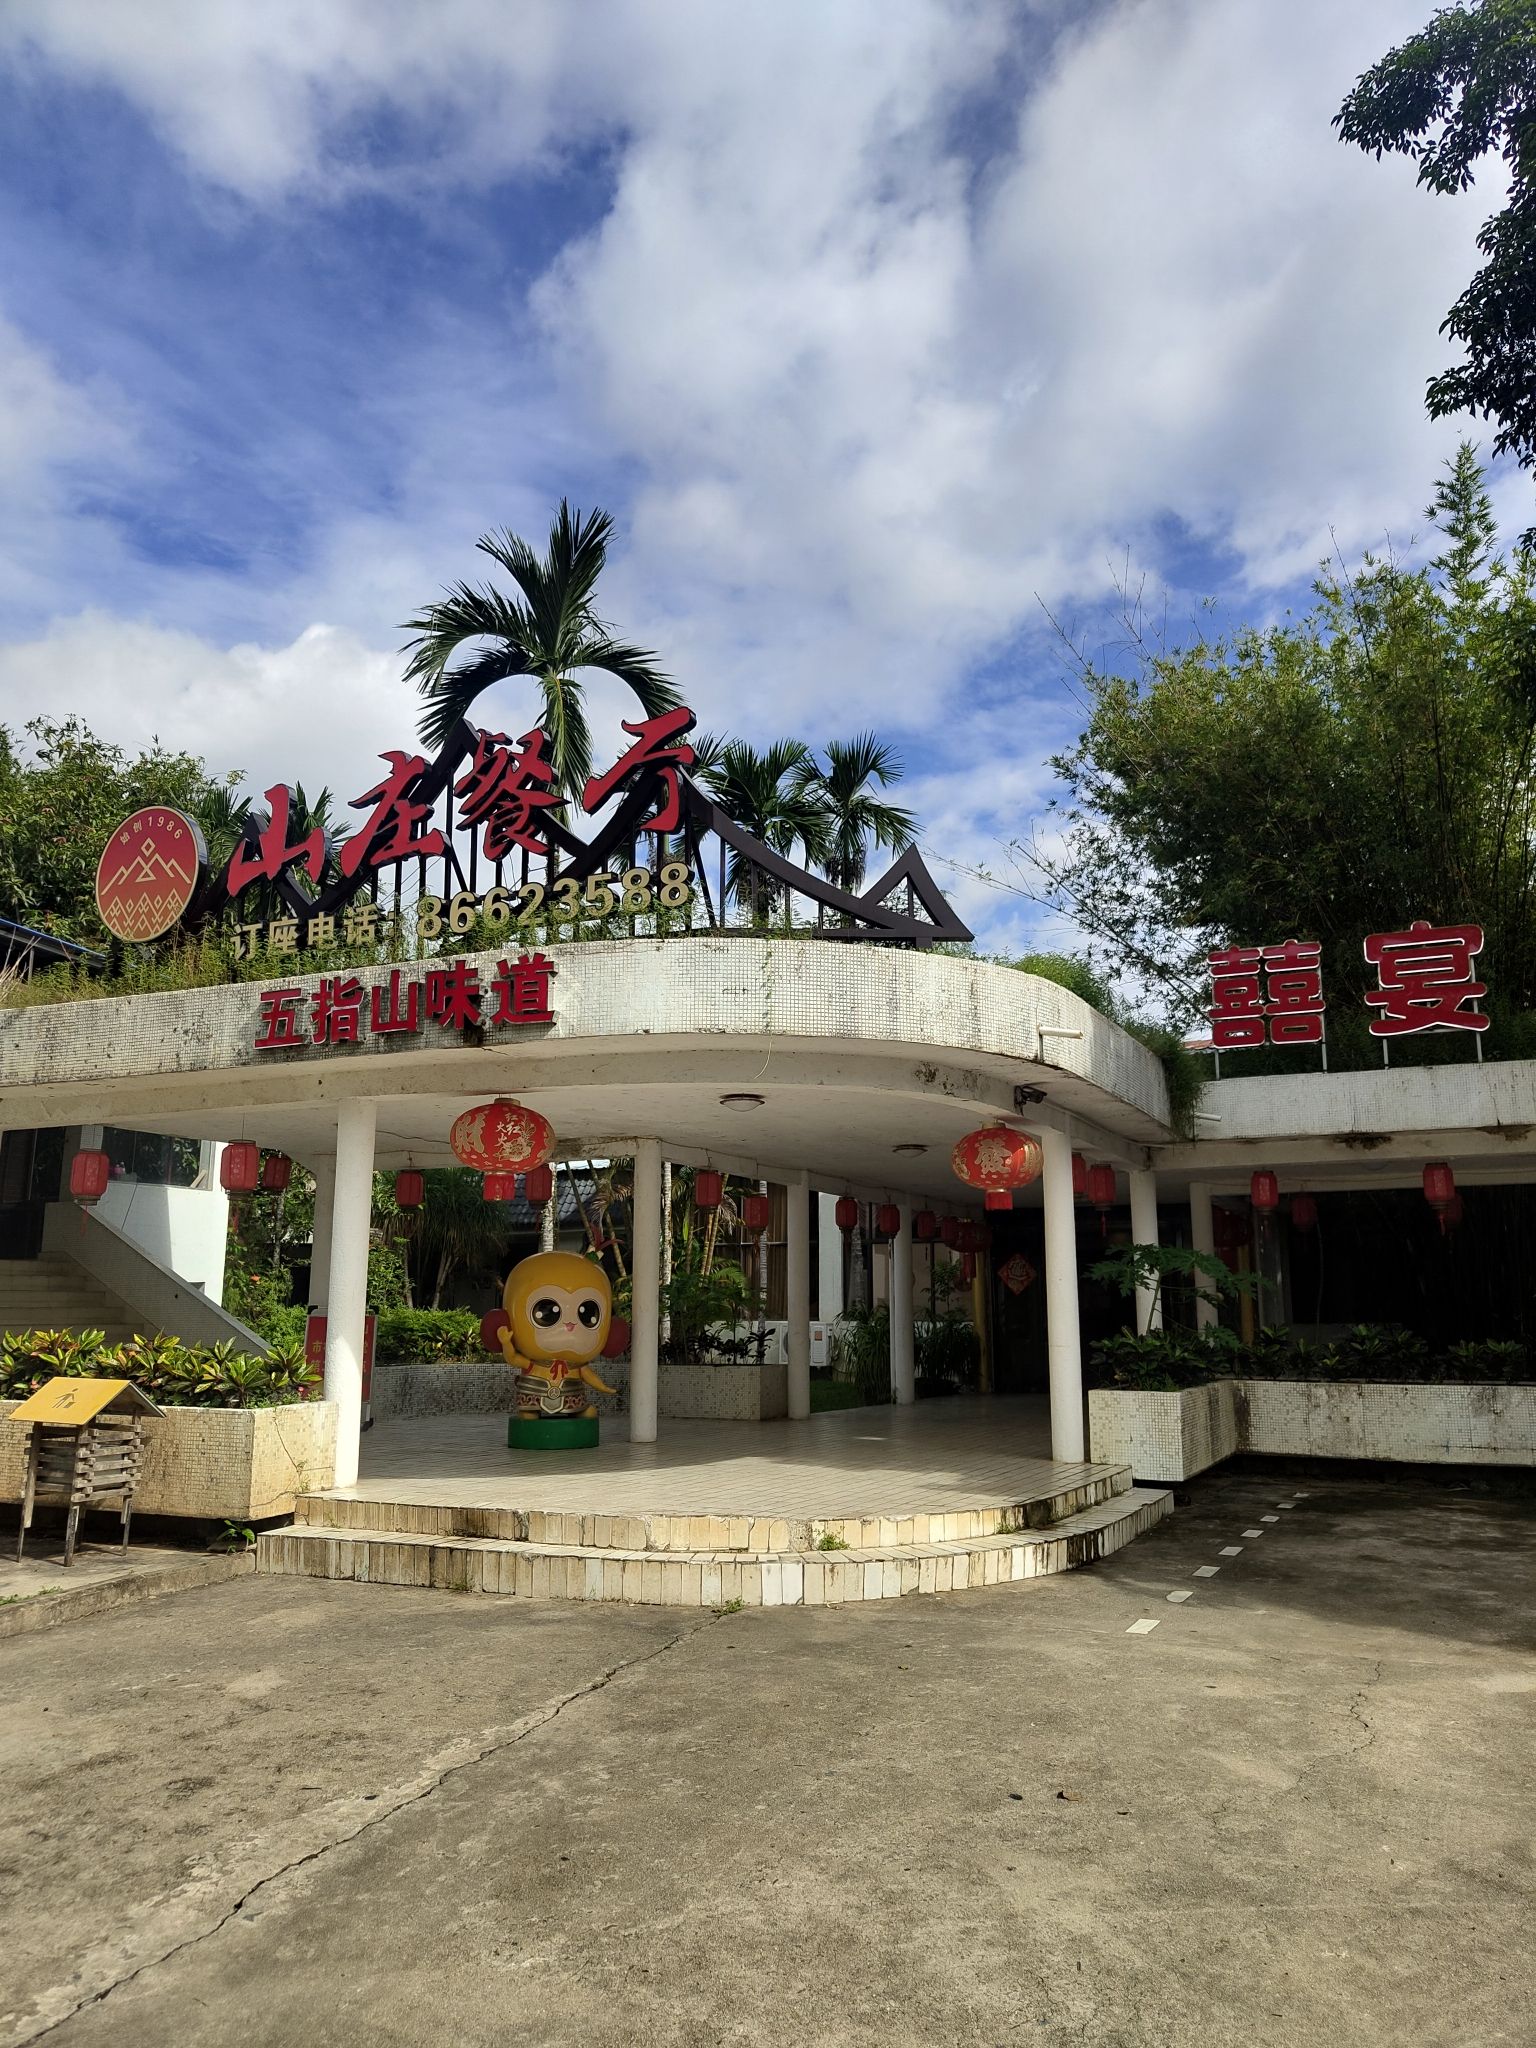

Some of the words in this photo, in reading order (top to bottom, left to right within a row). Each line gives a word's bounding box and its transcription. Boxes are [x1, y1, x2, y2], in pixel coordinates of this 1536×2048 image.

[417, 862, 690, 938] 86623588
[254, 952, 558, 1051] 五指山味道
